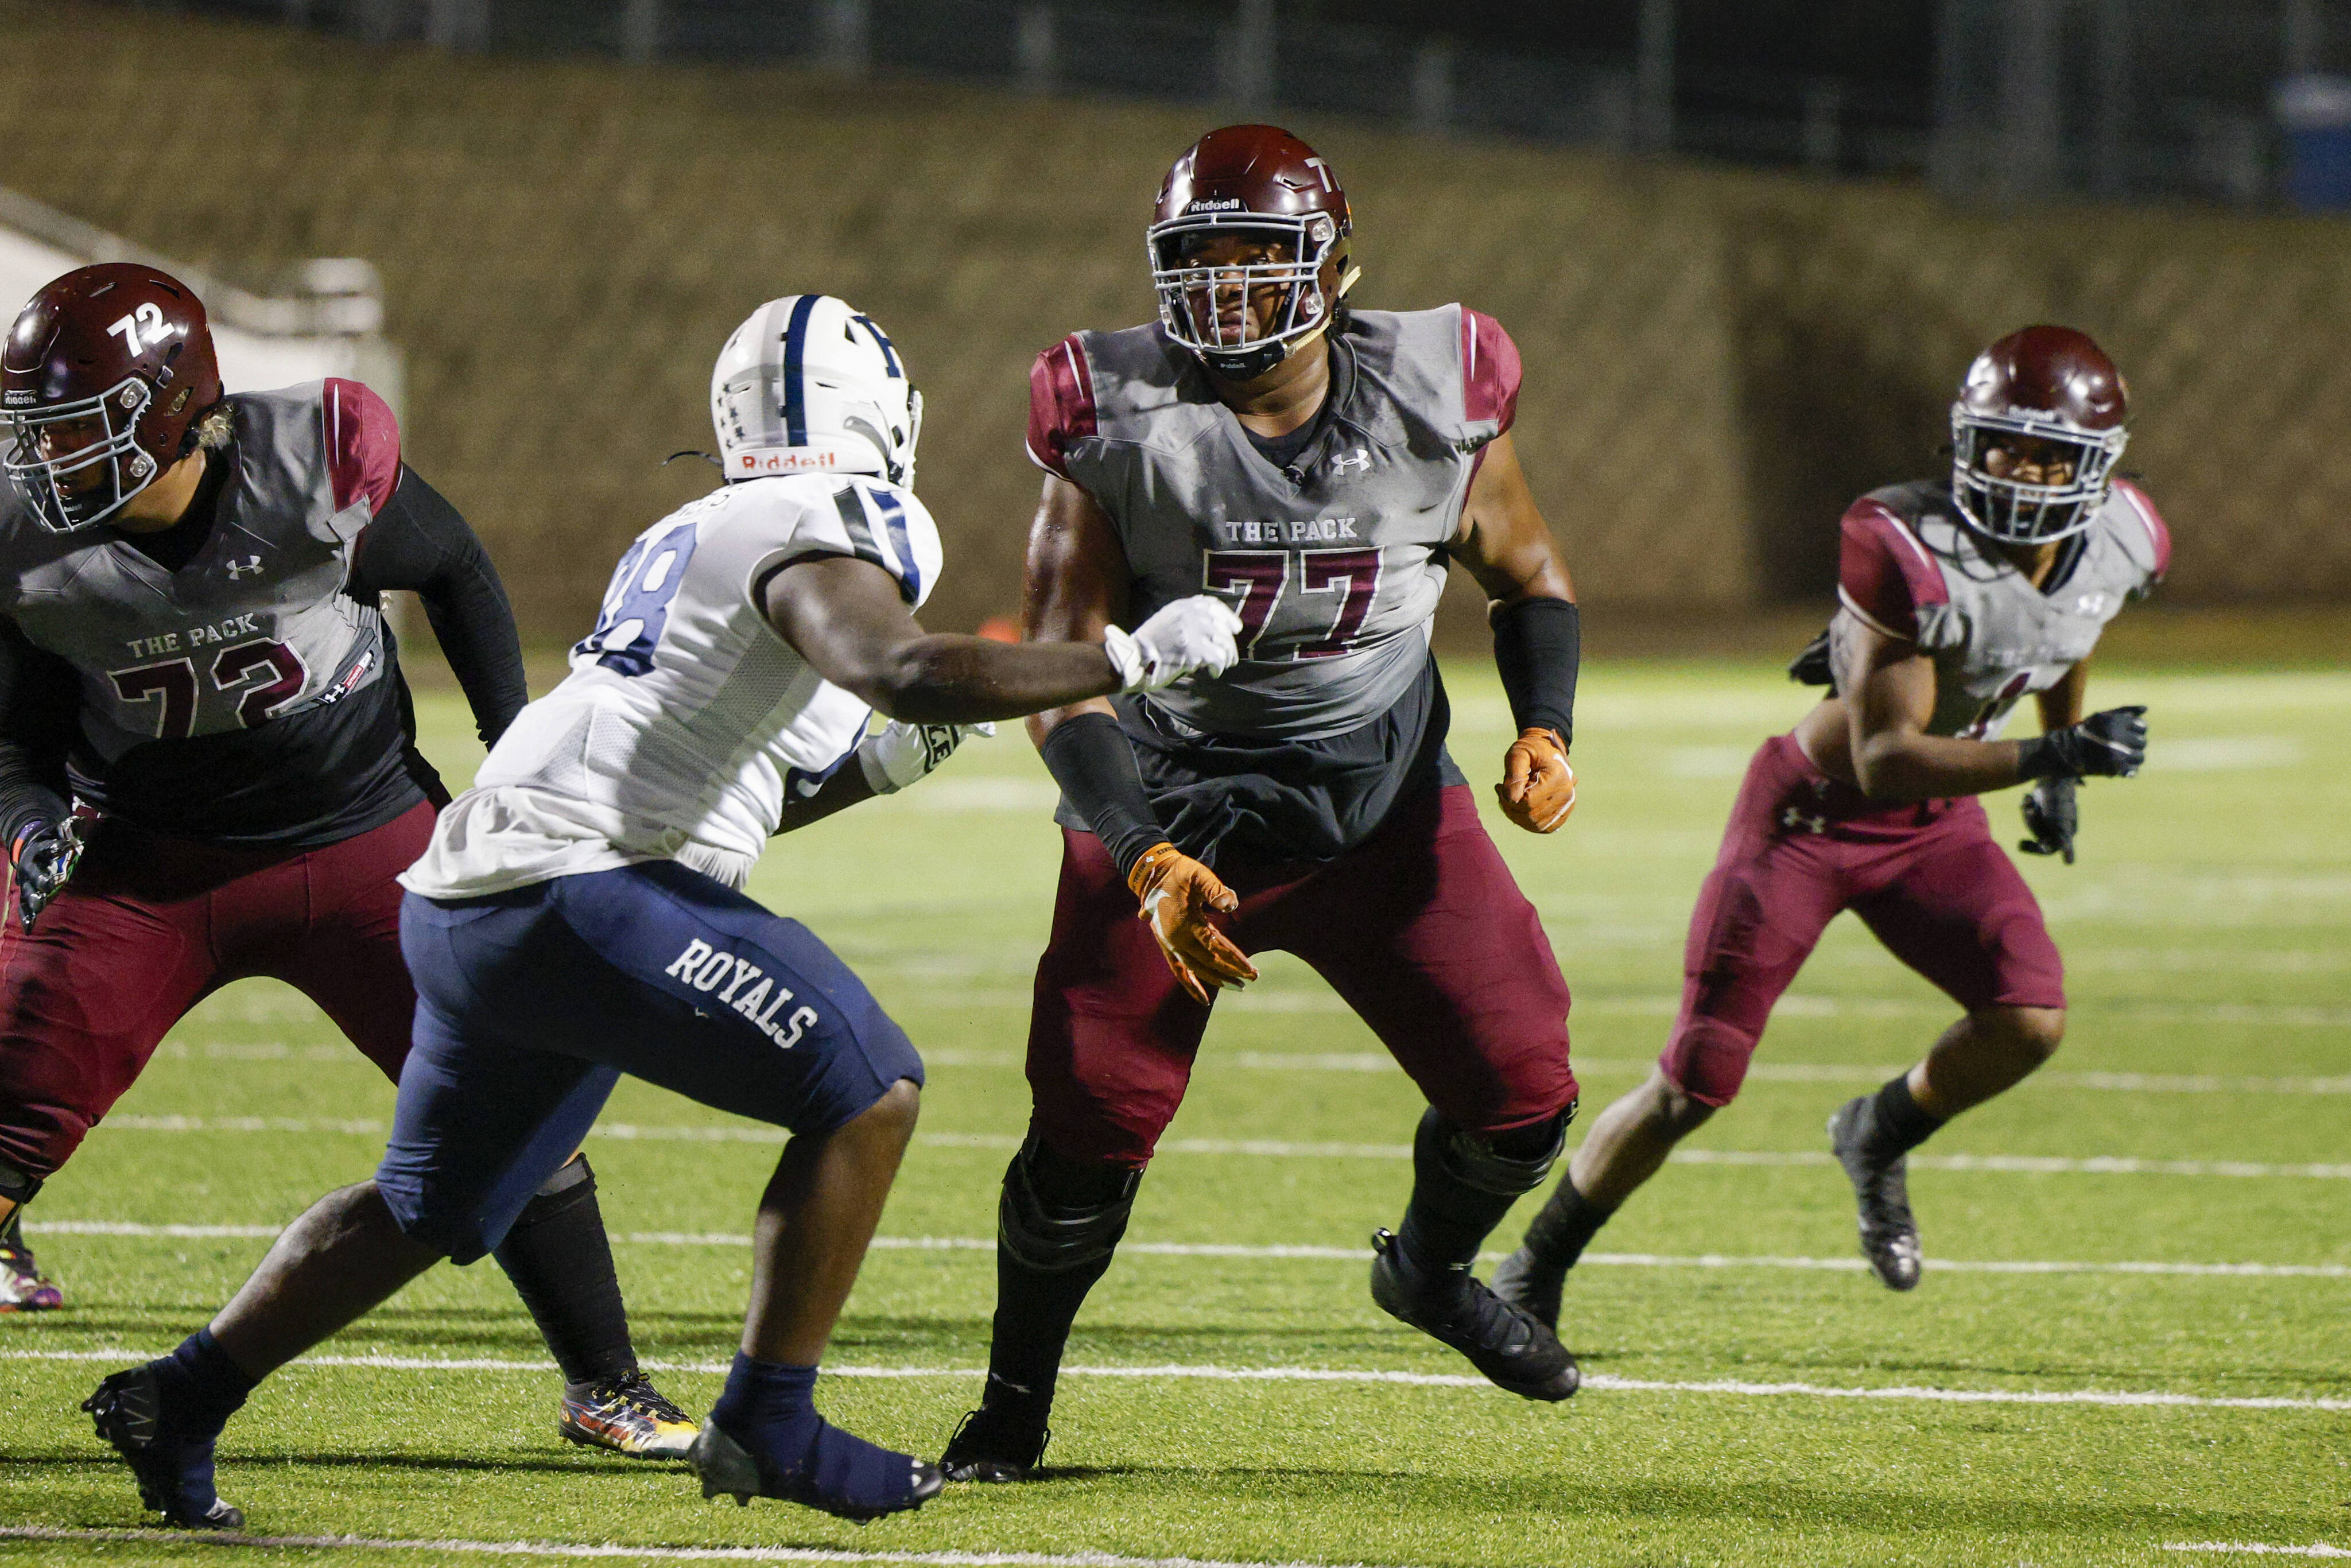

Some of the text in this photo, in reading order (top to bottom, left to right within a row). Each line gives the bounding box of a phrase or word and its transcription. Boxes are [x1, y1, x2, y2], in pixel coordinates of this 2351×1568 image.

[1303, 157, 1341, 193] 7
[1190, 198, 1240, 212] Riddell
[106, 302, 175, 358] 72
[742, 452, 836, 472] Riddell
[1225, 517, 1357, 542] THE PACK
[1203, 545, 1386, 662] 77
[126, 612, 259, 659] THE PACK
[106, 637, 311, 739] 72
[665, 937, 818, 1049] ROYALS
